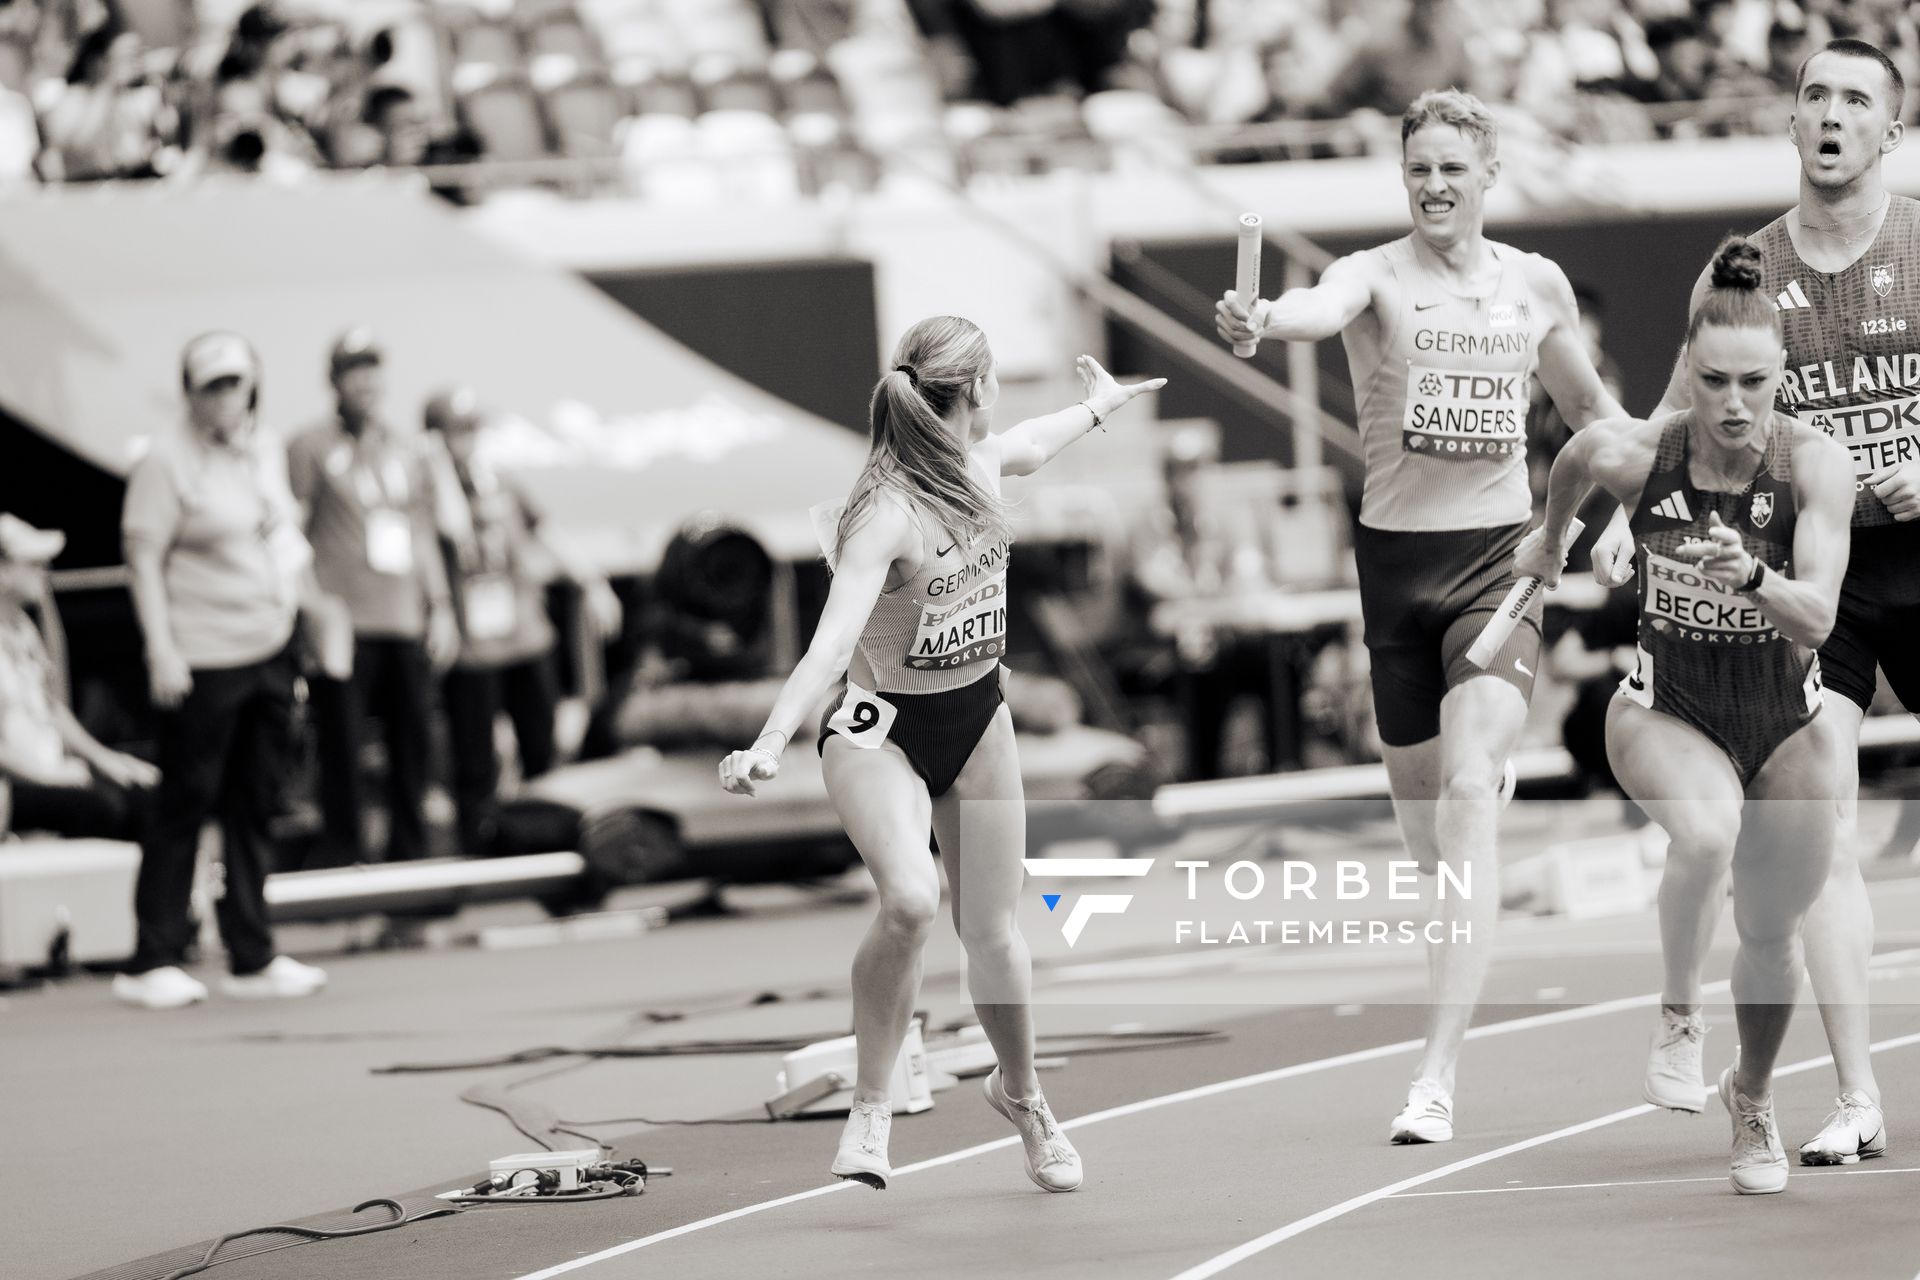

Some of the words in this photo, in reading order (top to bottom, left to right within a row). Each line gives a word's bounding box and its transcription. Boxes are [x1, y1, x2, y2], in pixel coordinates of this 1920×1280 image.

[1861, 317, 1907, 335] 123.ie
[1415, 329, 1531, 355] GERMANY
[1444, 375, 1516, 400] TDK
[1412, 404, 1516, 433] SANDERS
[1832, 401, 1920, 437] TDK
[927, 538, 1010, 597] GERMANY
[1508, 576, 1542, 620] MONDO
[1678, 627, 1780, 645] TOKYO25
[847, 701, 880, 734] 9
